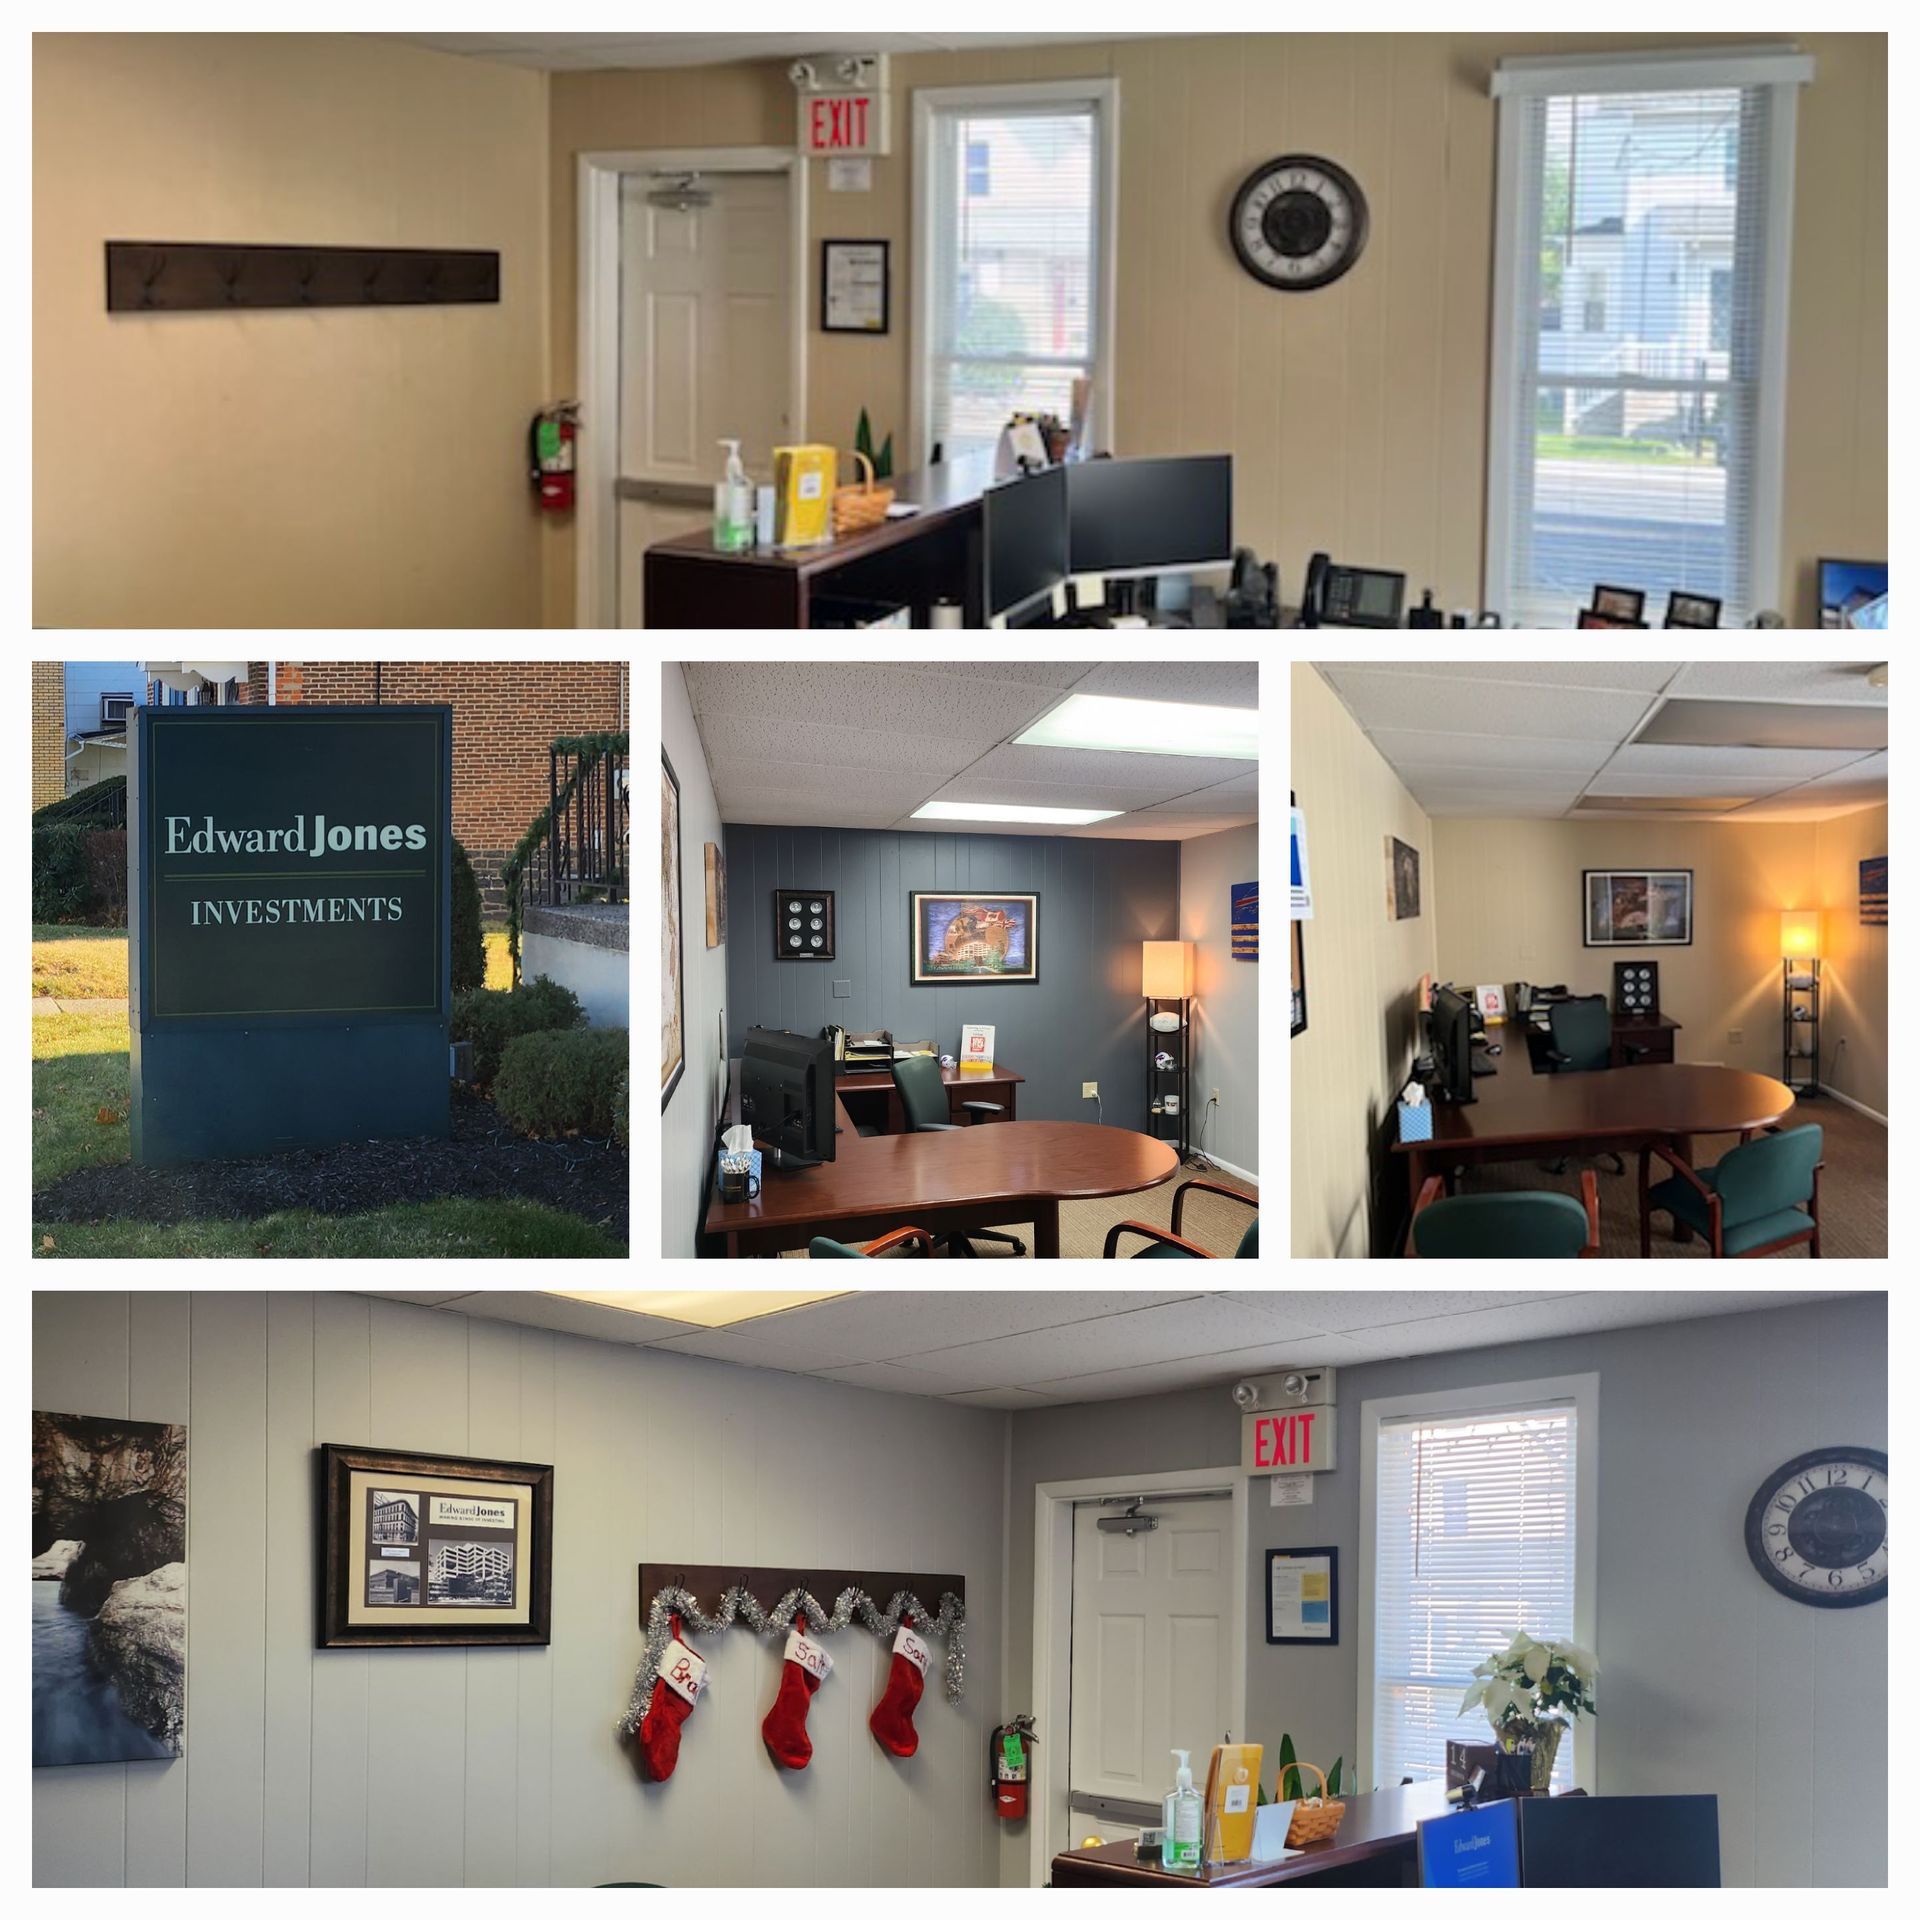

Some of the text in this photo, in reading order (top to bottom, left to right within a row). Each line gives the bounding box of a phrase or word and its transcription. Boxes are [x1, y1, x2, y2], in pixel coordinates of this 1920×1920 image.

[811, 98, 869, 148] EXIT
[191, 897, 404, 926] INVESTMENTS
[1255, 1413, 1316, 1468] EXIT
[1798, 1476, 1817, 1495] 11
[1827, 1470, 1848, 1486] 12
[1861, 1475, 1873, 1491] 1
[1775, 1494, 1798, 1515] 10
[1767, 1523, 1787, 1537] 9
[1774, 1546, 1795, 1563] 8
[1799, 1562, 1816, 1579] 7
[1828, 1569, 1844, 1587] 6
[1857, 1561, 1876, 1581] 5
